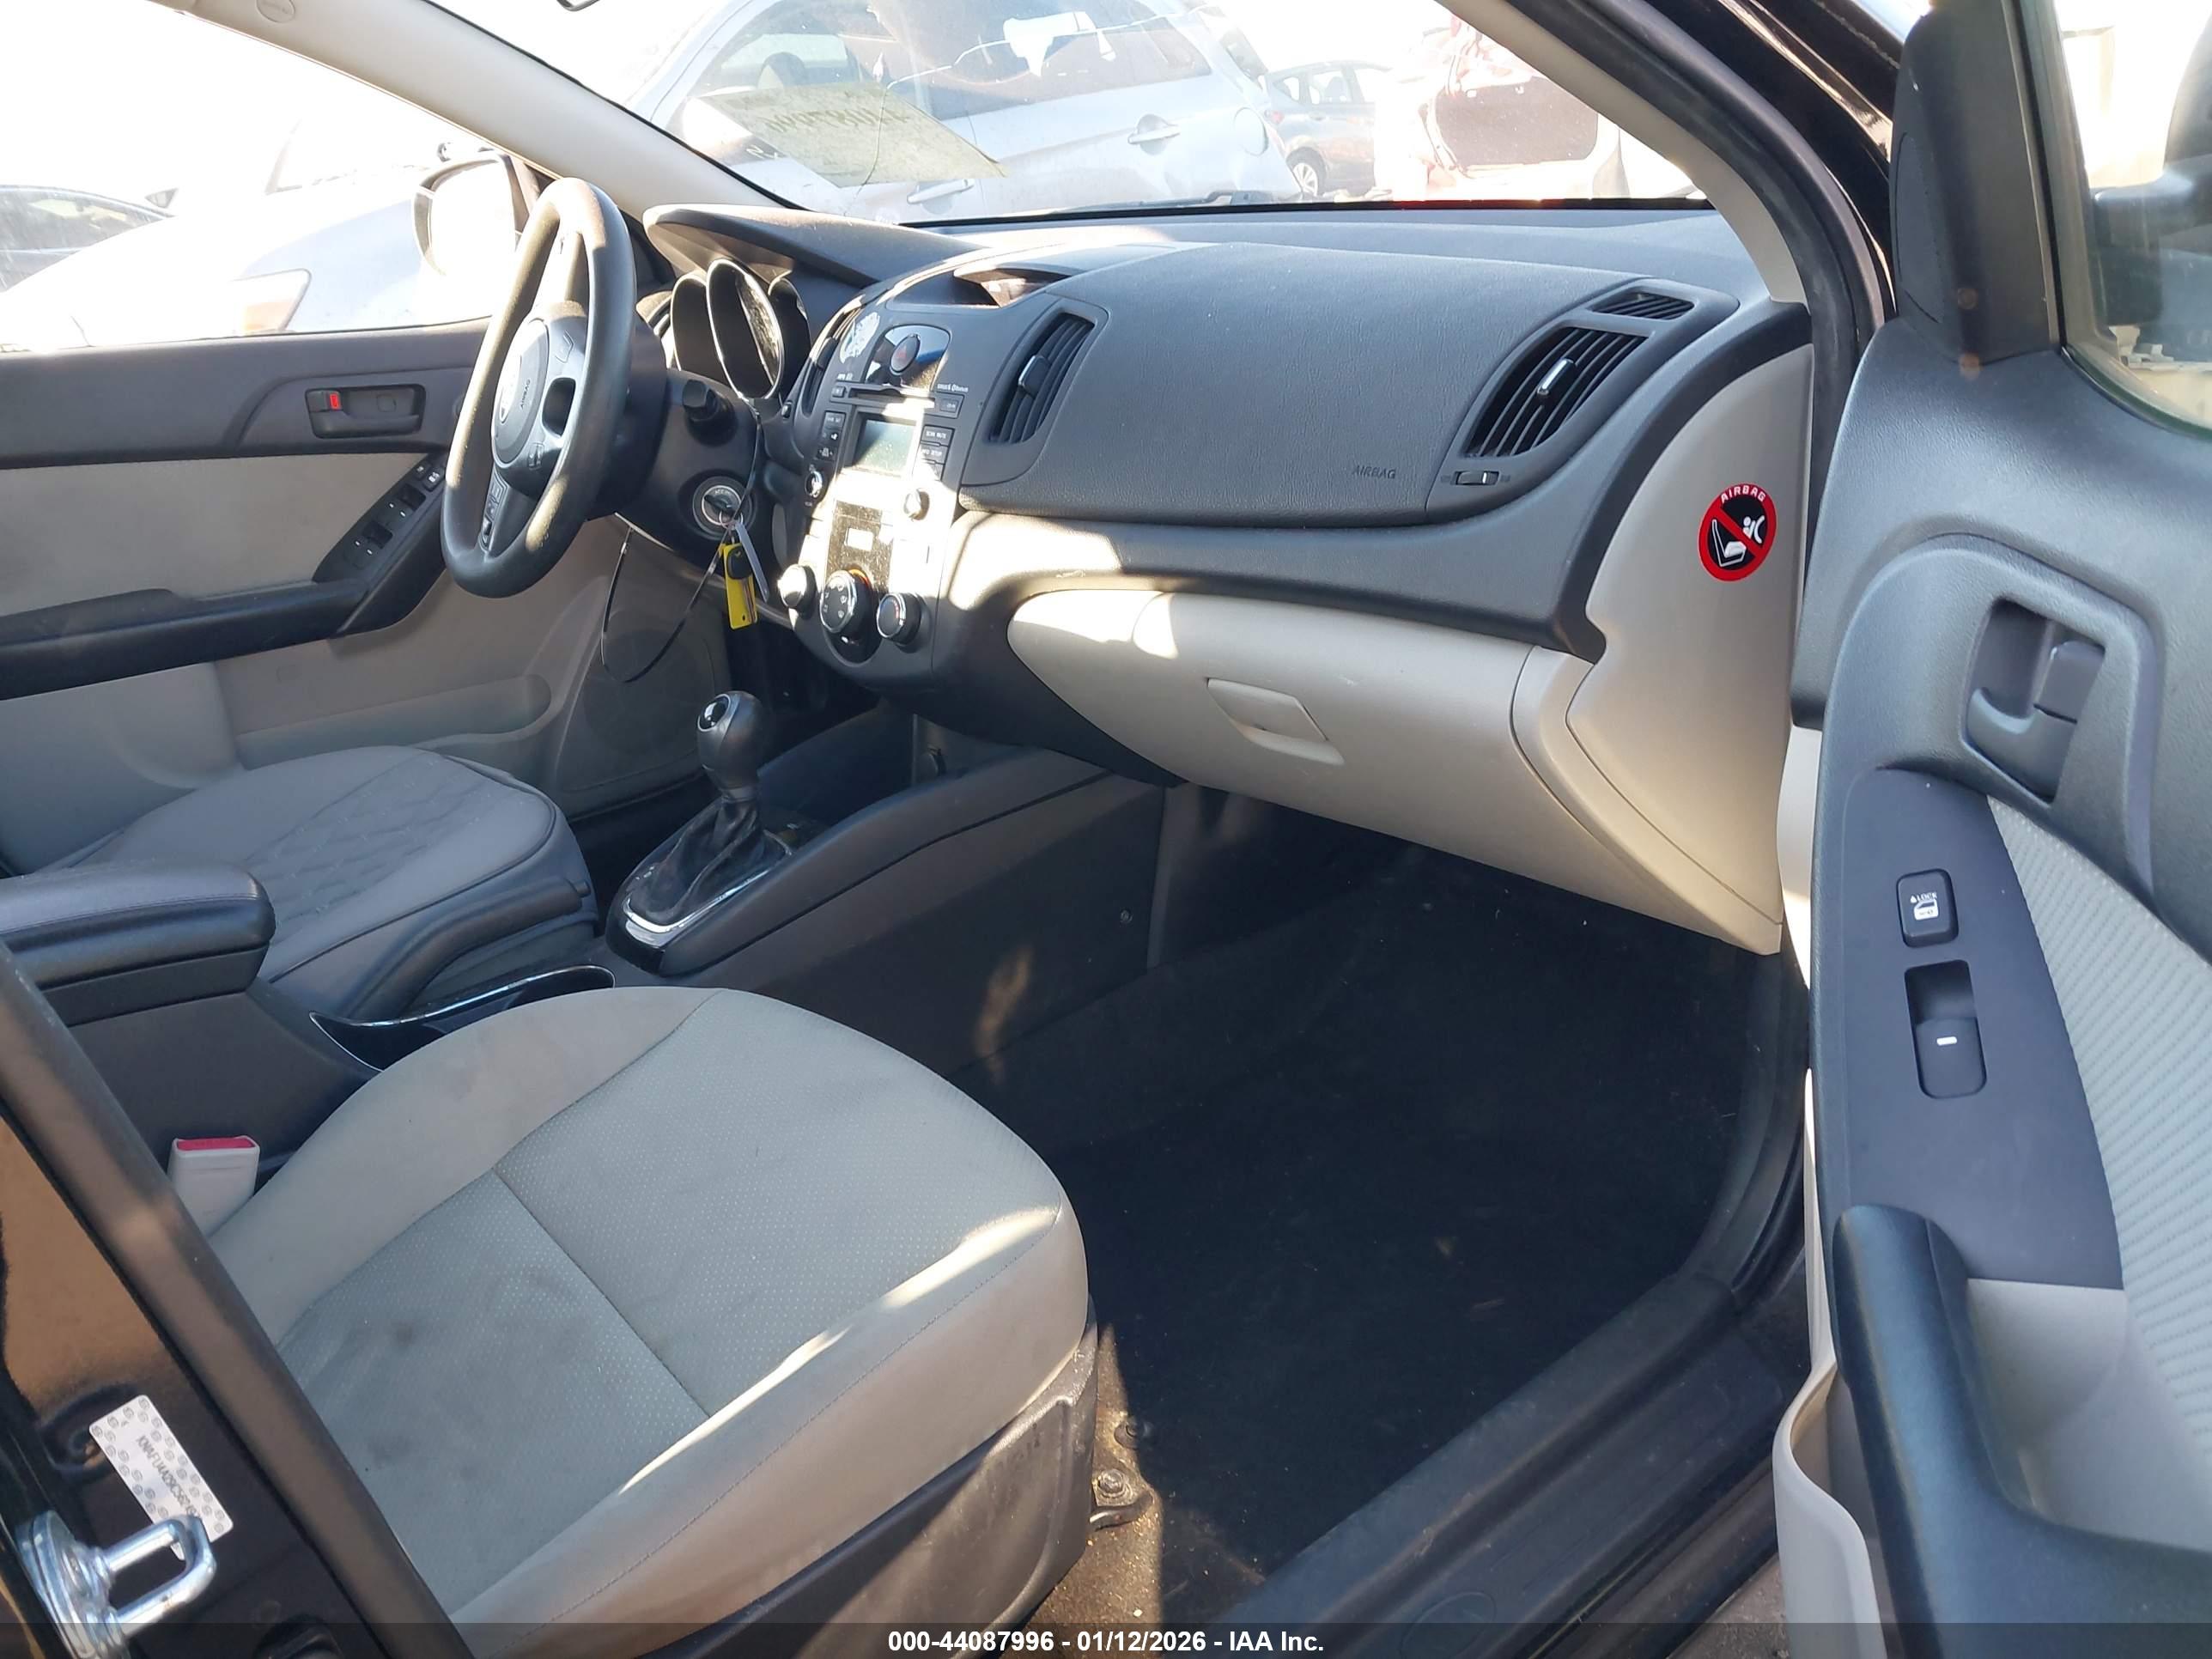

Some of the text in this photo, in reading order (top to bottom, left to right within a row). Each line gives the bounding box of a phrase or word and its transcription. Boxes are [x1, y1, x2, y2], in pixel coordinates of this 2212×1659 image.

[1352, 465, 1396, 479] AIRBAG
[1720, 484, 1766, 505] AIRBAG
[1917, 891, 1937, 902] LOCK
